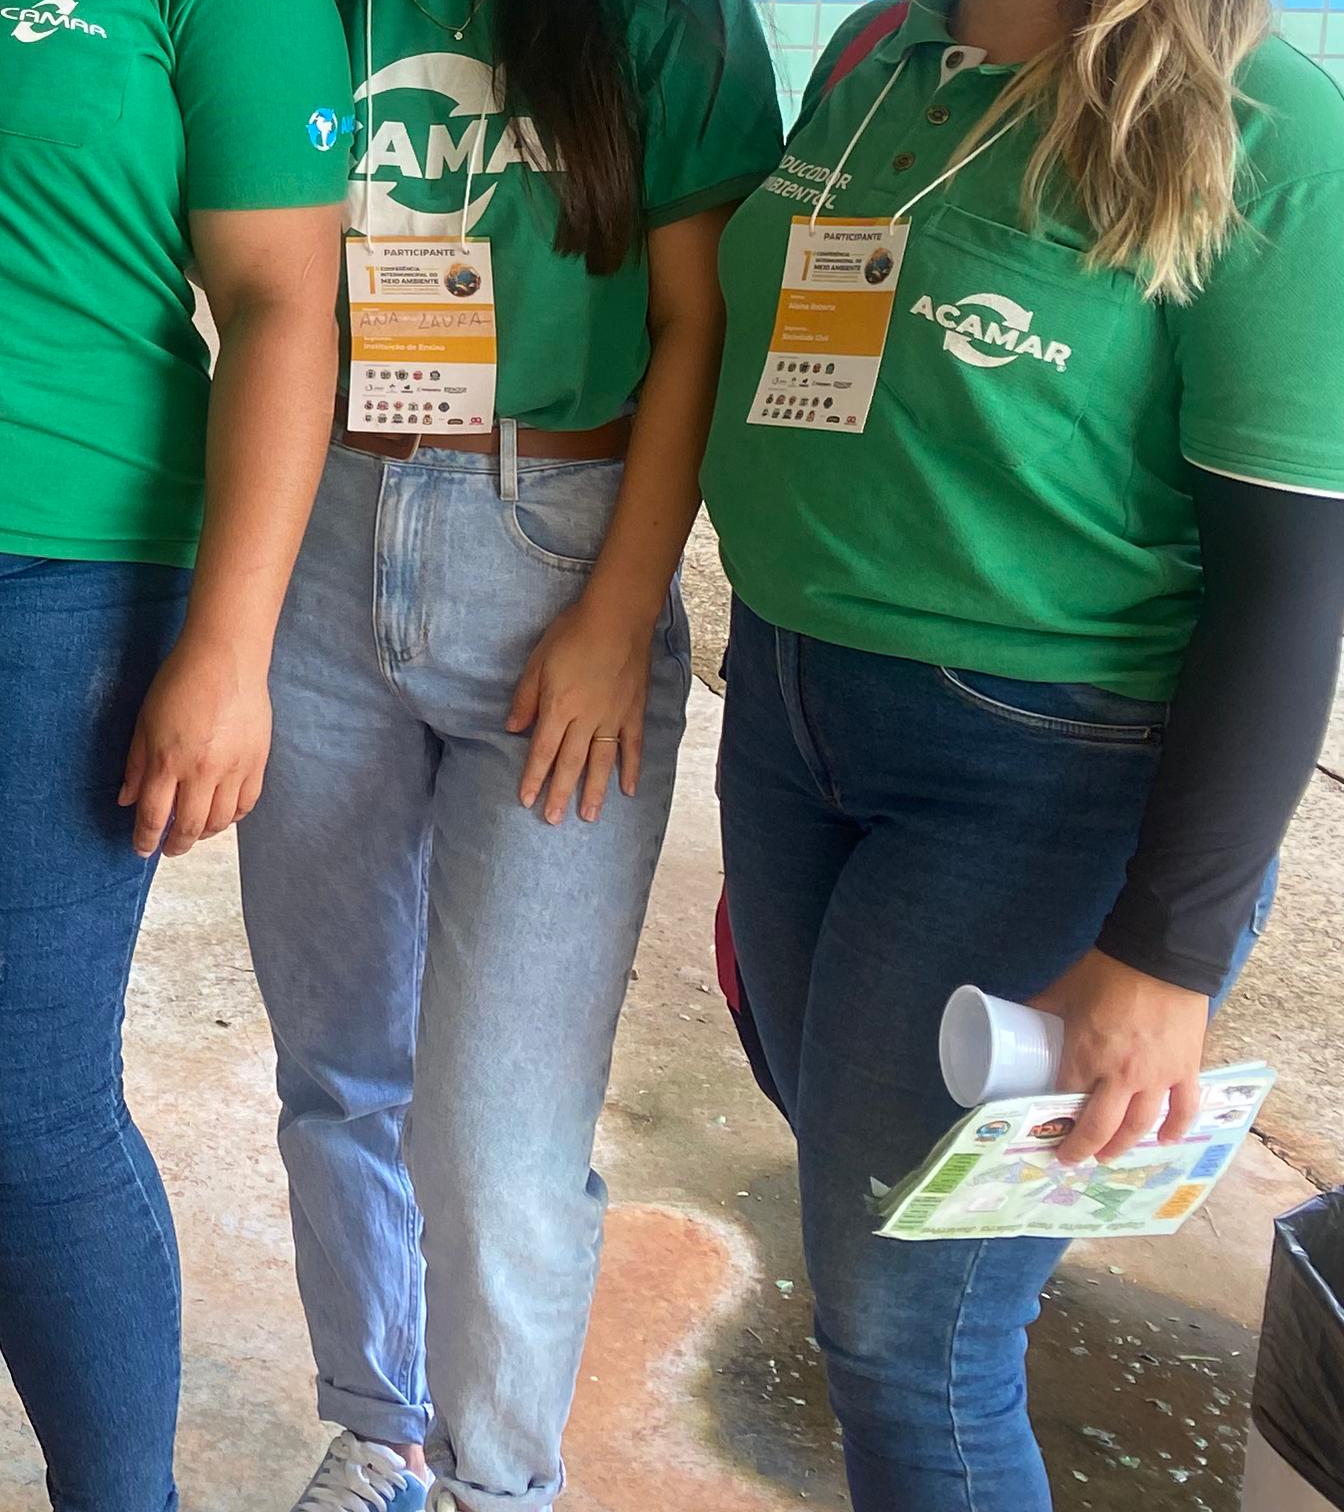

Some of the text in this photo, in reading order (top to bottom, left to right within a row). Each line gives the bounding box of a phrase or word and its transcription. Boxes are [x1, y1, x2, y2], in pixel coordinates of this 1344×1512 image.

[823, 232, 883, 241] PARTICIPANTE
[383, 248, 456, 257] PARTICIPANTE
[359, 312, 399, 328] ANA
[910, 295, 1073, 366] ACAMAR
